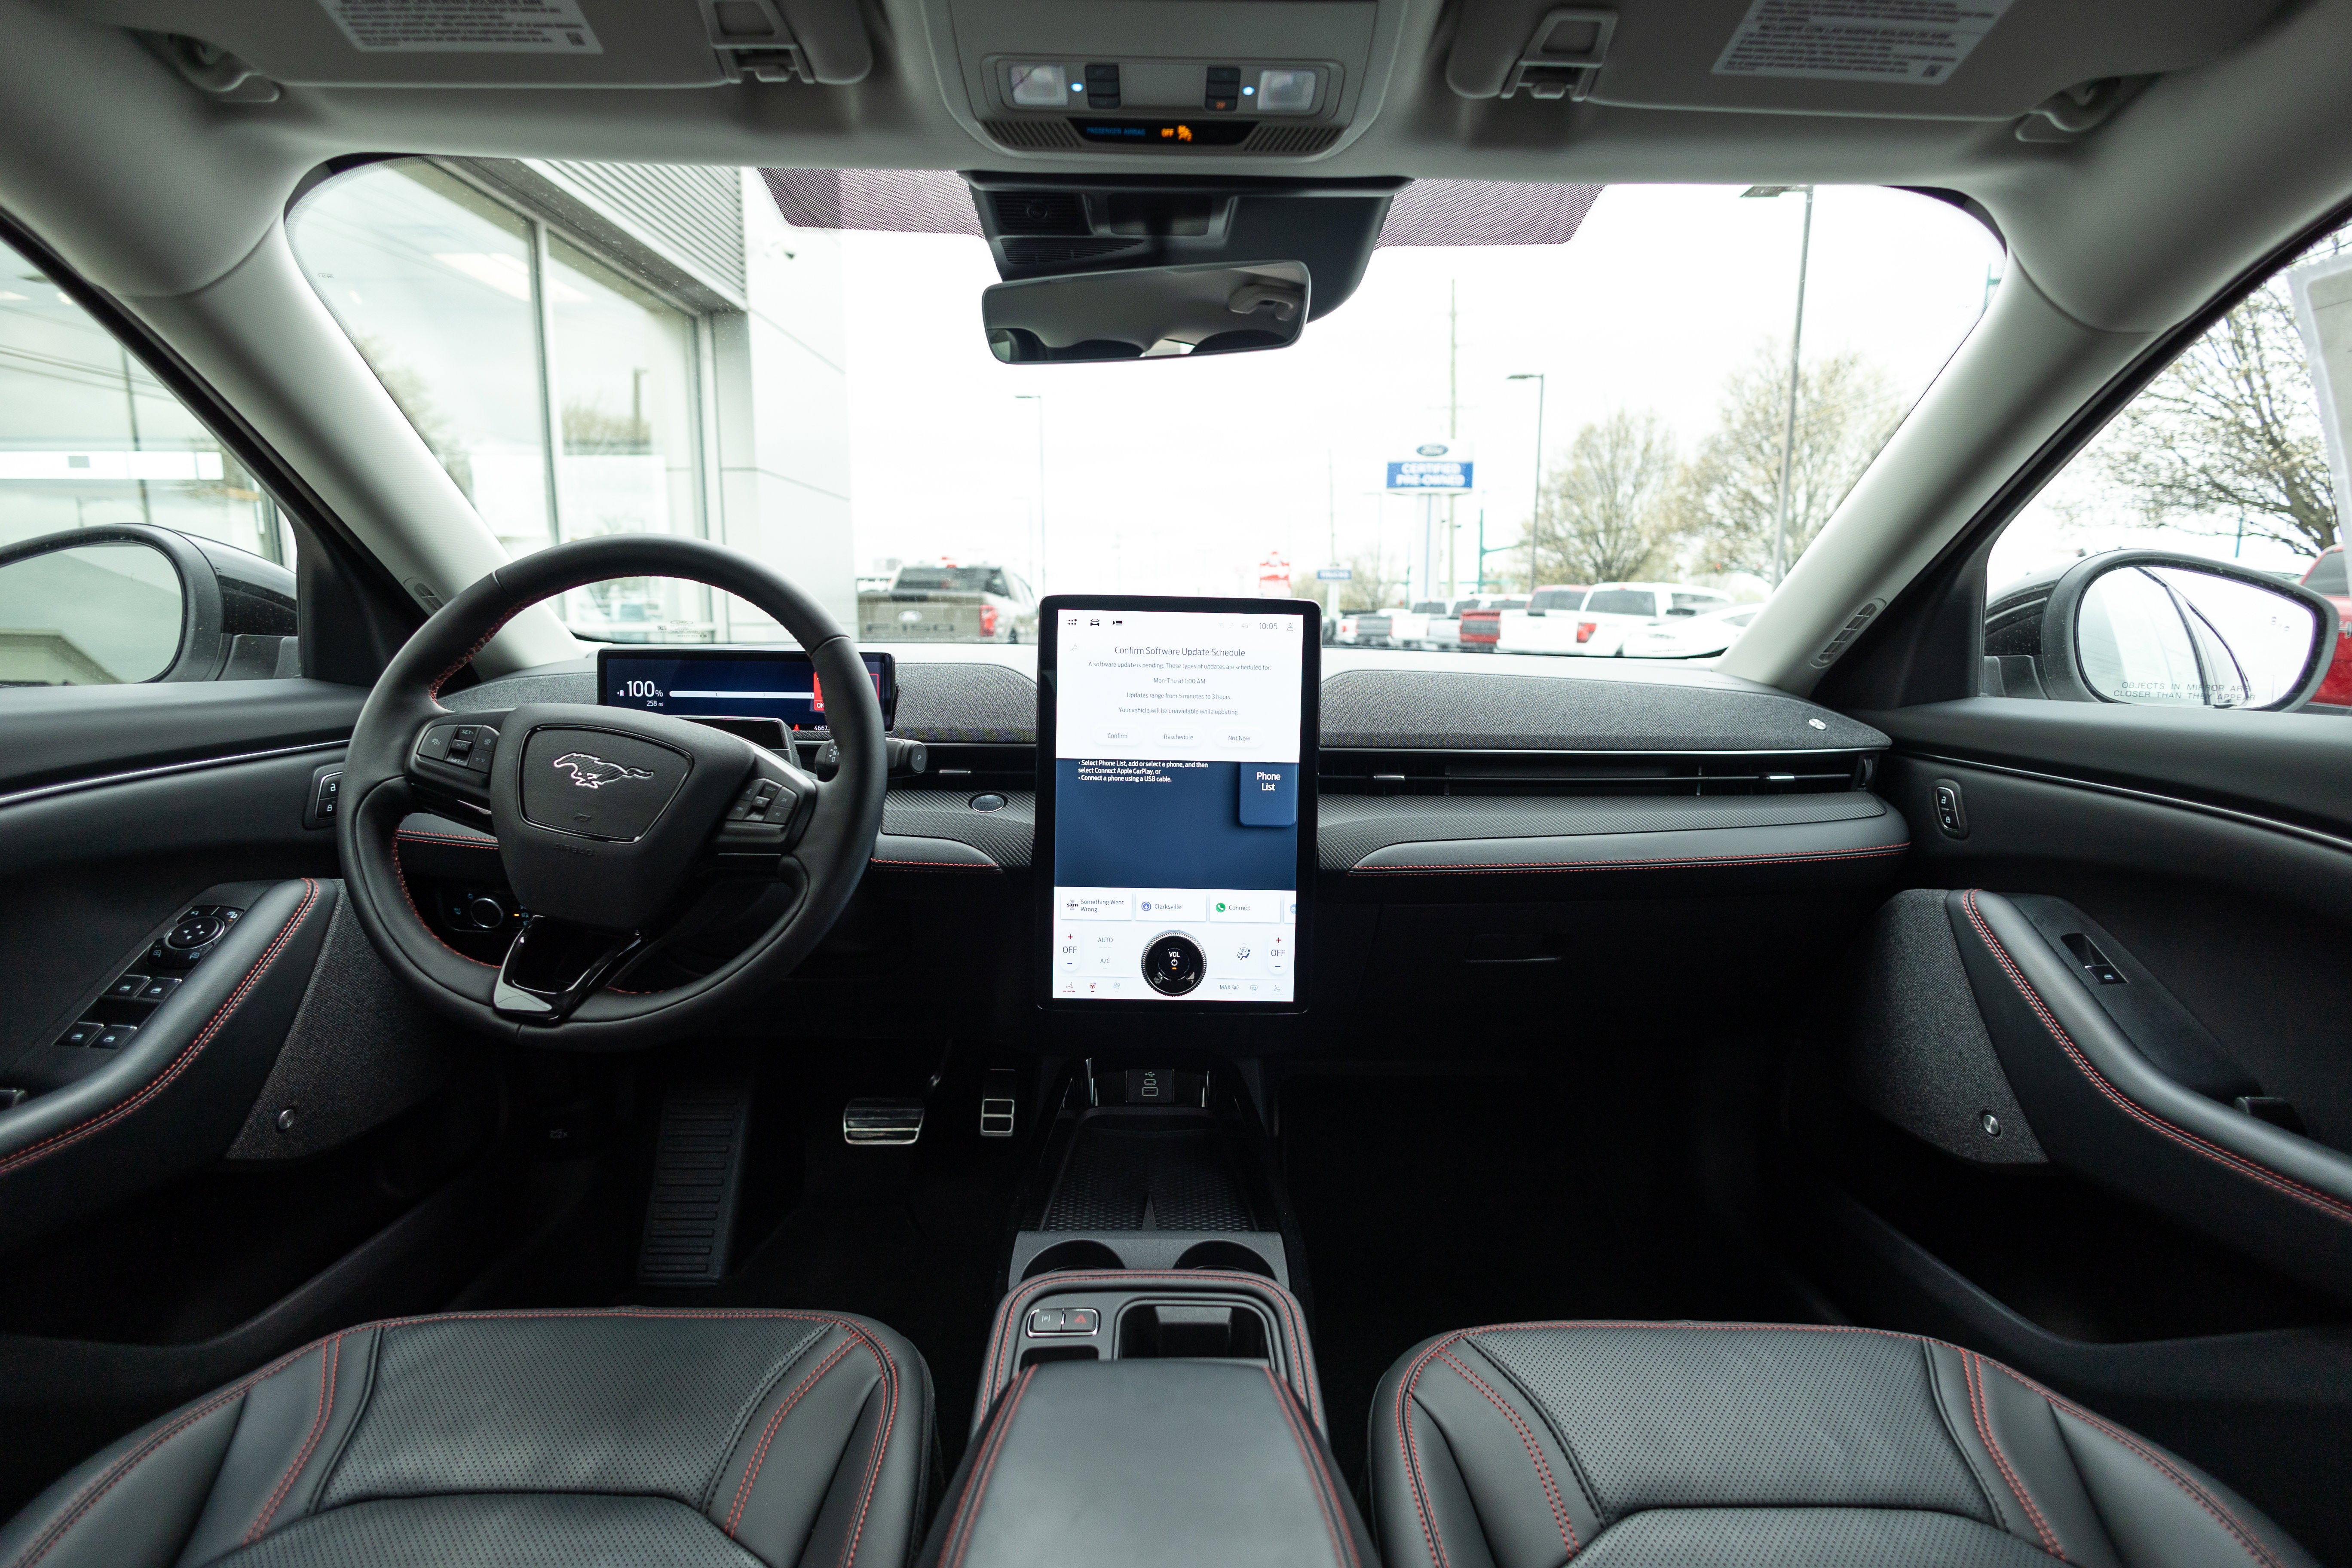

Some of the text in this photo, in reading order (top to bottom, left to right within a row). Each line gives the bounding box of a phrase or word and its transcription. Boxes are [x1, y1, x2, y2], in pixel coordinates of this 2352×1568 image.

[1161, 128, 1174, 138] OFF
[1115, 646, 1245, 657] Confirm Software Update Schedule
[627, 680, 664, 697] 100%
[1257, 772, 1281, 781] Phone
[1262, 782, 1275, 791] List
